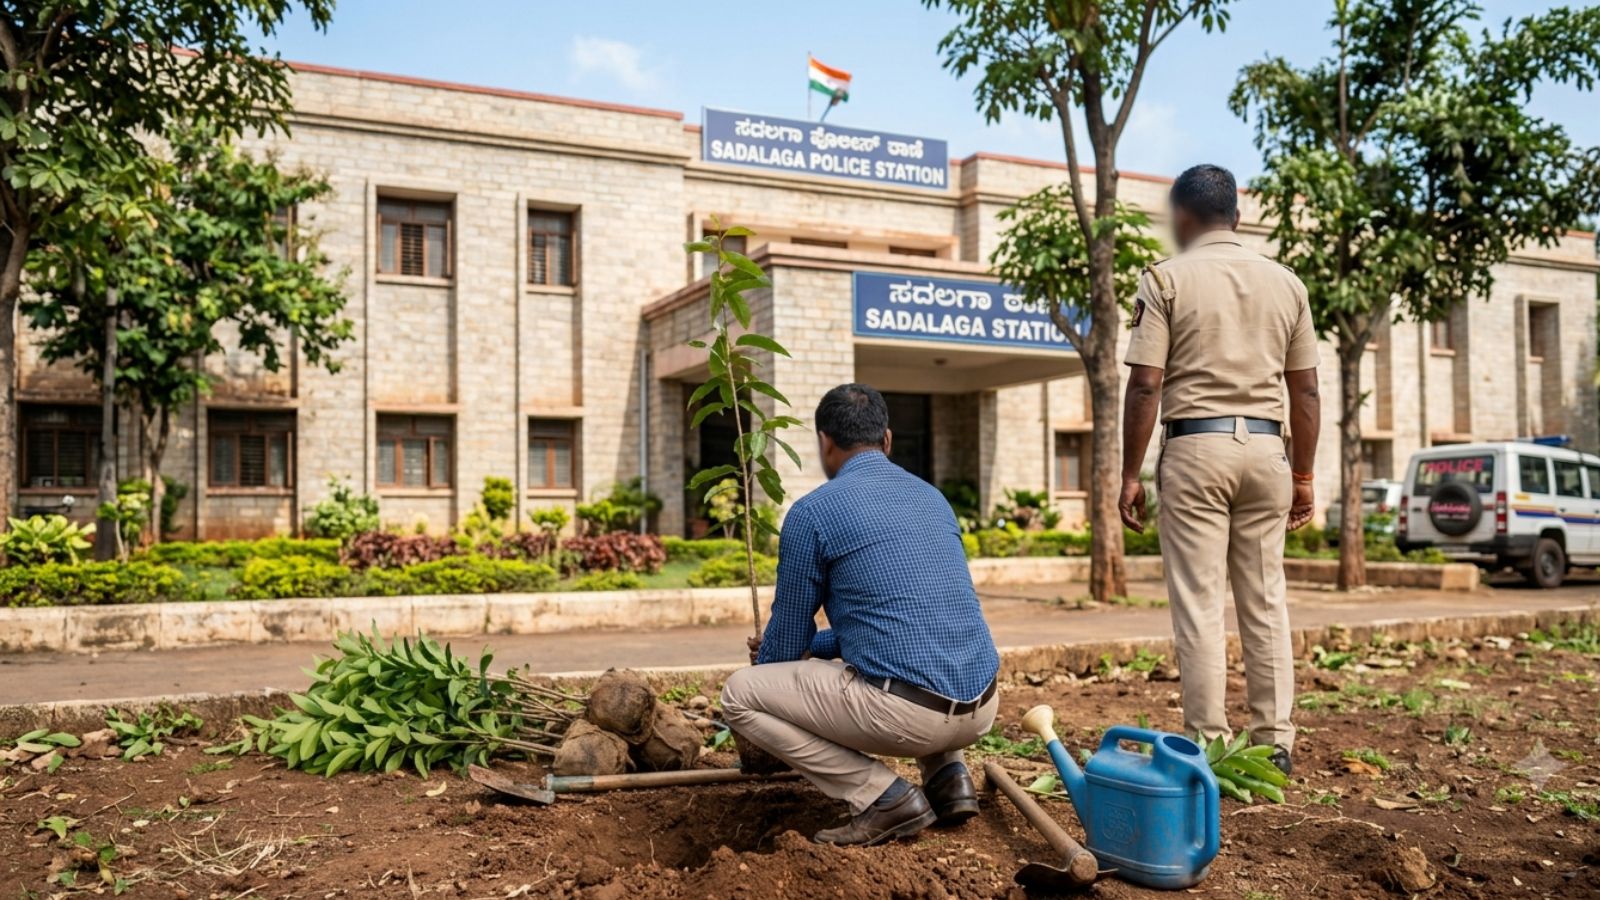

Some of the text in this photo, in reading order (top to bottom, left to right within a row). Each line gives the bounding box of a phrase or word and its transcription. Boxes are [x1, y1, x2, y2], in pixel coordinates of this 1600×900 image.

[735, 118, 804, 143] ಸದಲಗಾ
[711, 140, 944, 186] SADALAGA POLICE STATION
[889, 280, 992, 311] ಸದಲಗಾ
[866, 308, 987, 337] SADALAGA
[1424, 459, 1483, 474] POLICE
